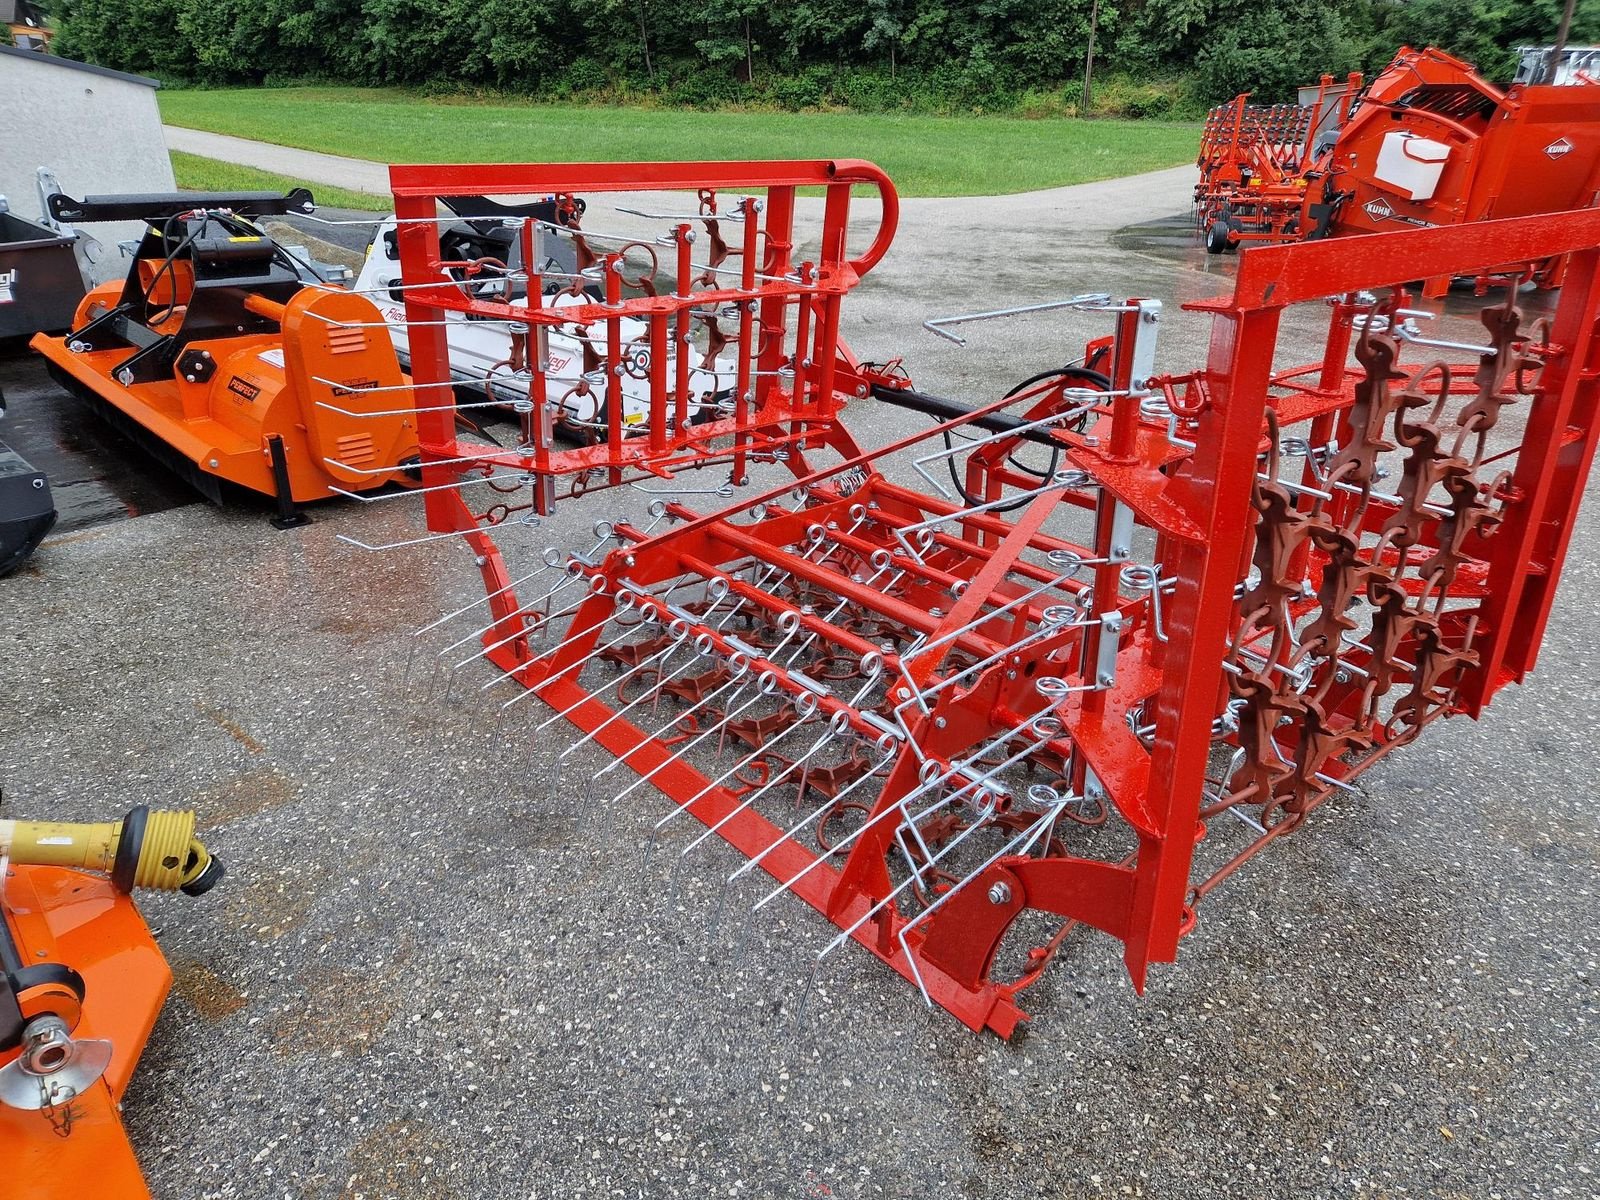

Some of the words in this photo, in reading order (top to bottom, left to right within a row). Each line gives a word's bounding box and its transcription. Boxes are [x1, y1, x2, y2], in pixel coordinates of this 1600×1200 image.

[1547, 145, 1570, 154] KUHN
[1366, 203, 1391, 216] KUHN
[229, 378, 259, 399] PERFECT
